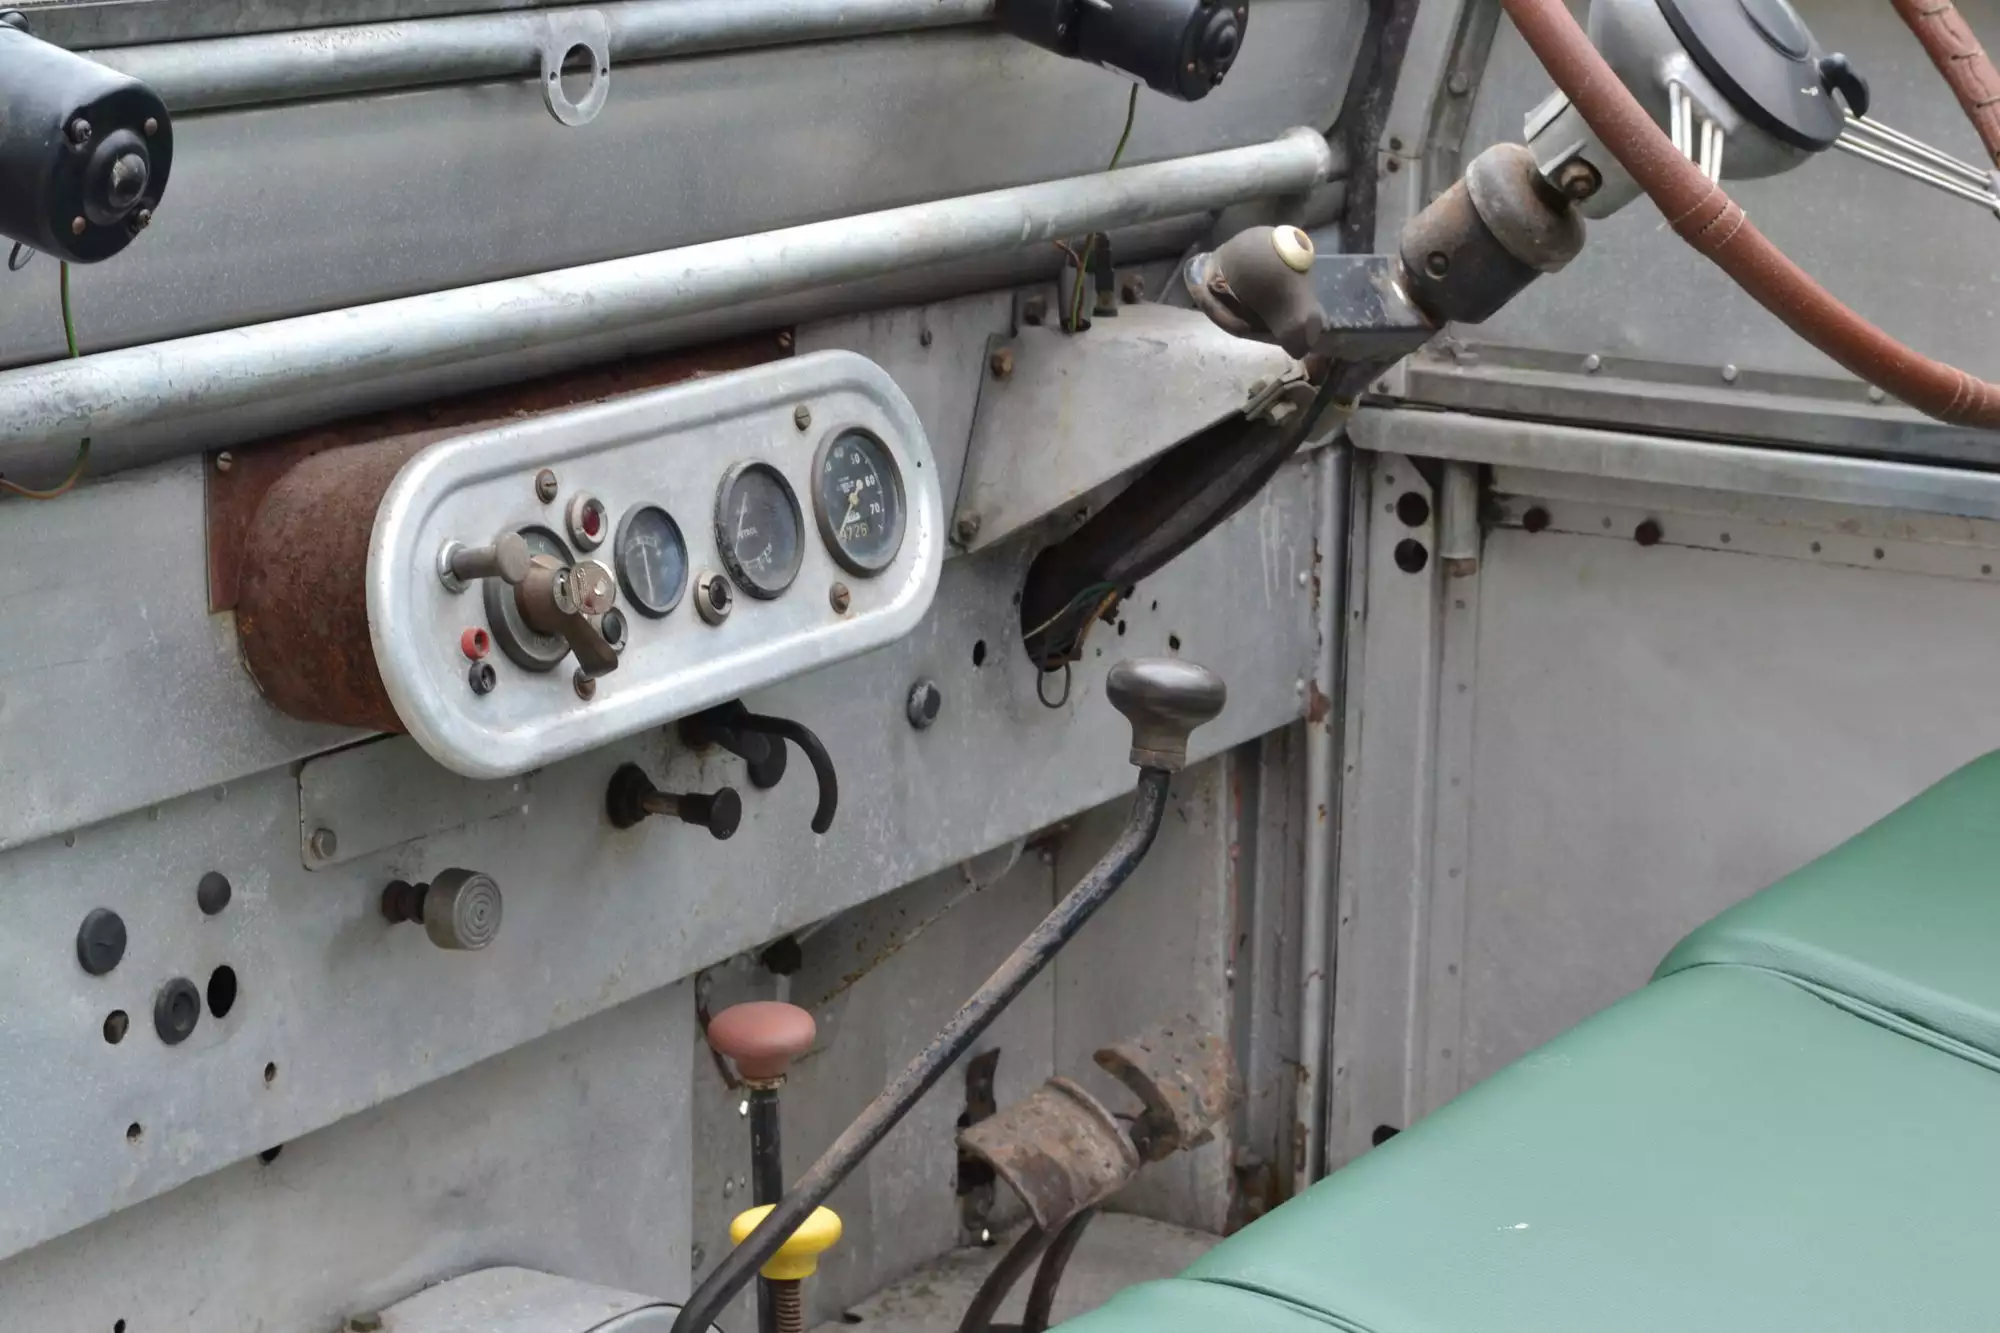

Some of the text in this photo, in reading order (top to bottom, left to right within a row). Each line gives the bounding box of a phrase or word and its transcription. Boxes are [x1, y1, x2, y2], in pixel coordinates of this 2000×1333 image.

[850, 453, 861, 465] 50
[865, 474, 876, 488] 60
[869, 502, 881, 515] 70
